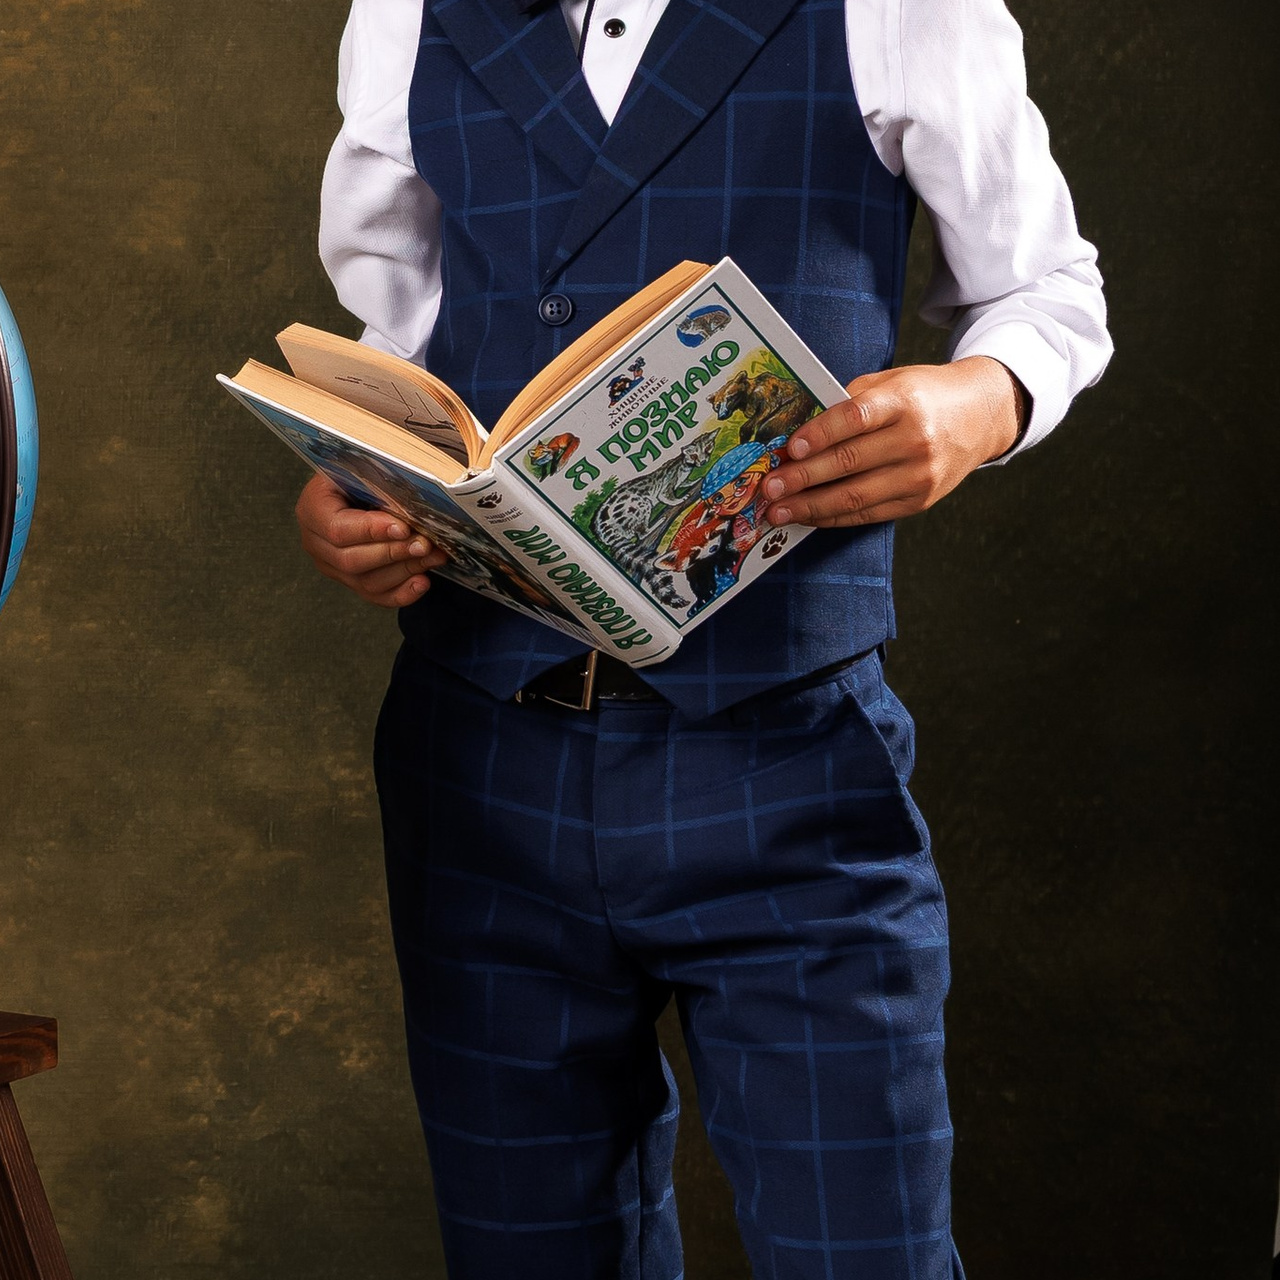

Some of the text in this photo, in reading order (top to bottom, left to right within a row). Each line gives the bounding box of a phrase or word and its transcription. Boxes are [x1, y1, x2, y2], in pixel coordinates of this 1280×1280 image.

[564, 340, 740, 491] Я ПОЗНАЮ
[607, 375, 658, 419] ХИЩНЫЕ
[608, 376, 669, 429] ЖИВОТНЫЕ
[626, 400, 698, 472] МИР
[502, 524, 653, 651] Я ПОЗНАЮ МИР
